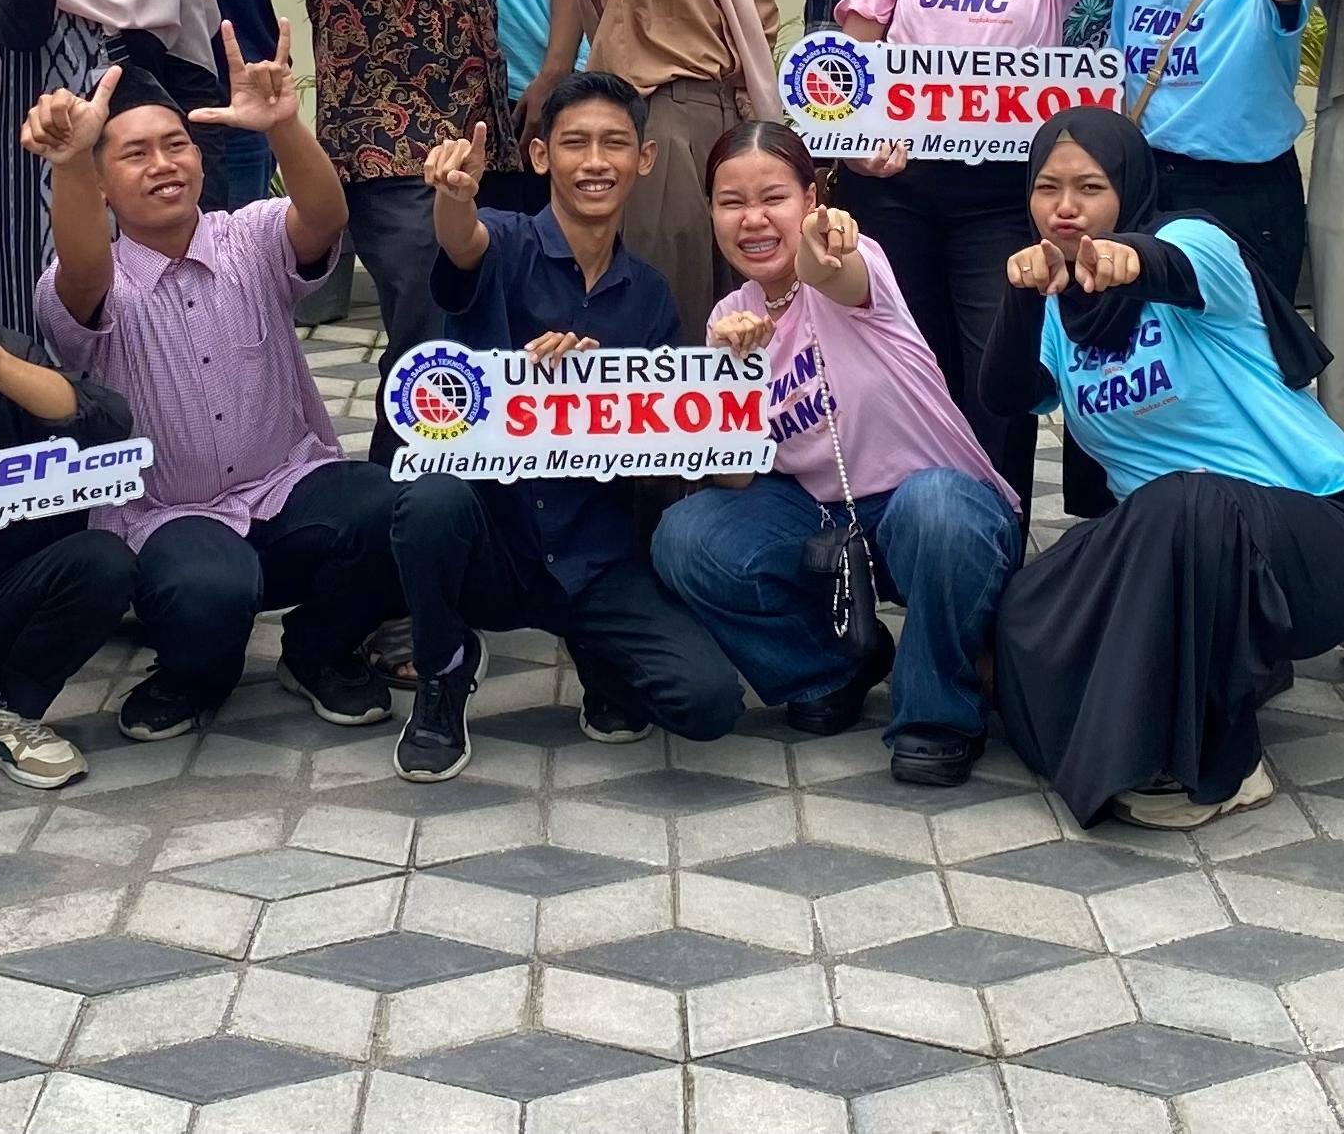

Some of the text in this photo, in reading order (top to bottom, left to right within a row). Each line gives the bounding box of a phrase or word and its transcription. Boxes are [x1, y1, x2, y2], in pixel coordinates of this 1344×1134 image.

[886, 49, 1118, 79] UNIVERSITAS
[1125, 45, 1199, 77] KEJA
[886, 83, 1116, 123] STEKOM
[504, 353, 764, 385] UNIVERSITAS
[1077, 359, 1172, 416] KERJA
[505, 390, 764, 438] STEKOM
[414, 424, 469, 440] STEKOM
[398, 450, 537, 477] Kuliahnya
[546, 446, 753, 473] Menyenangkan
[72, 479, 137, 505] Kerja
